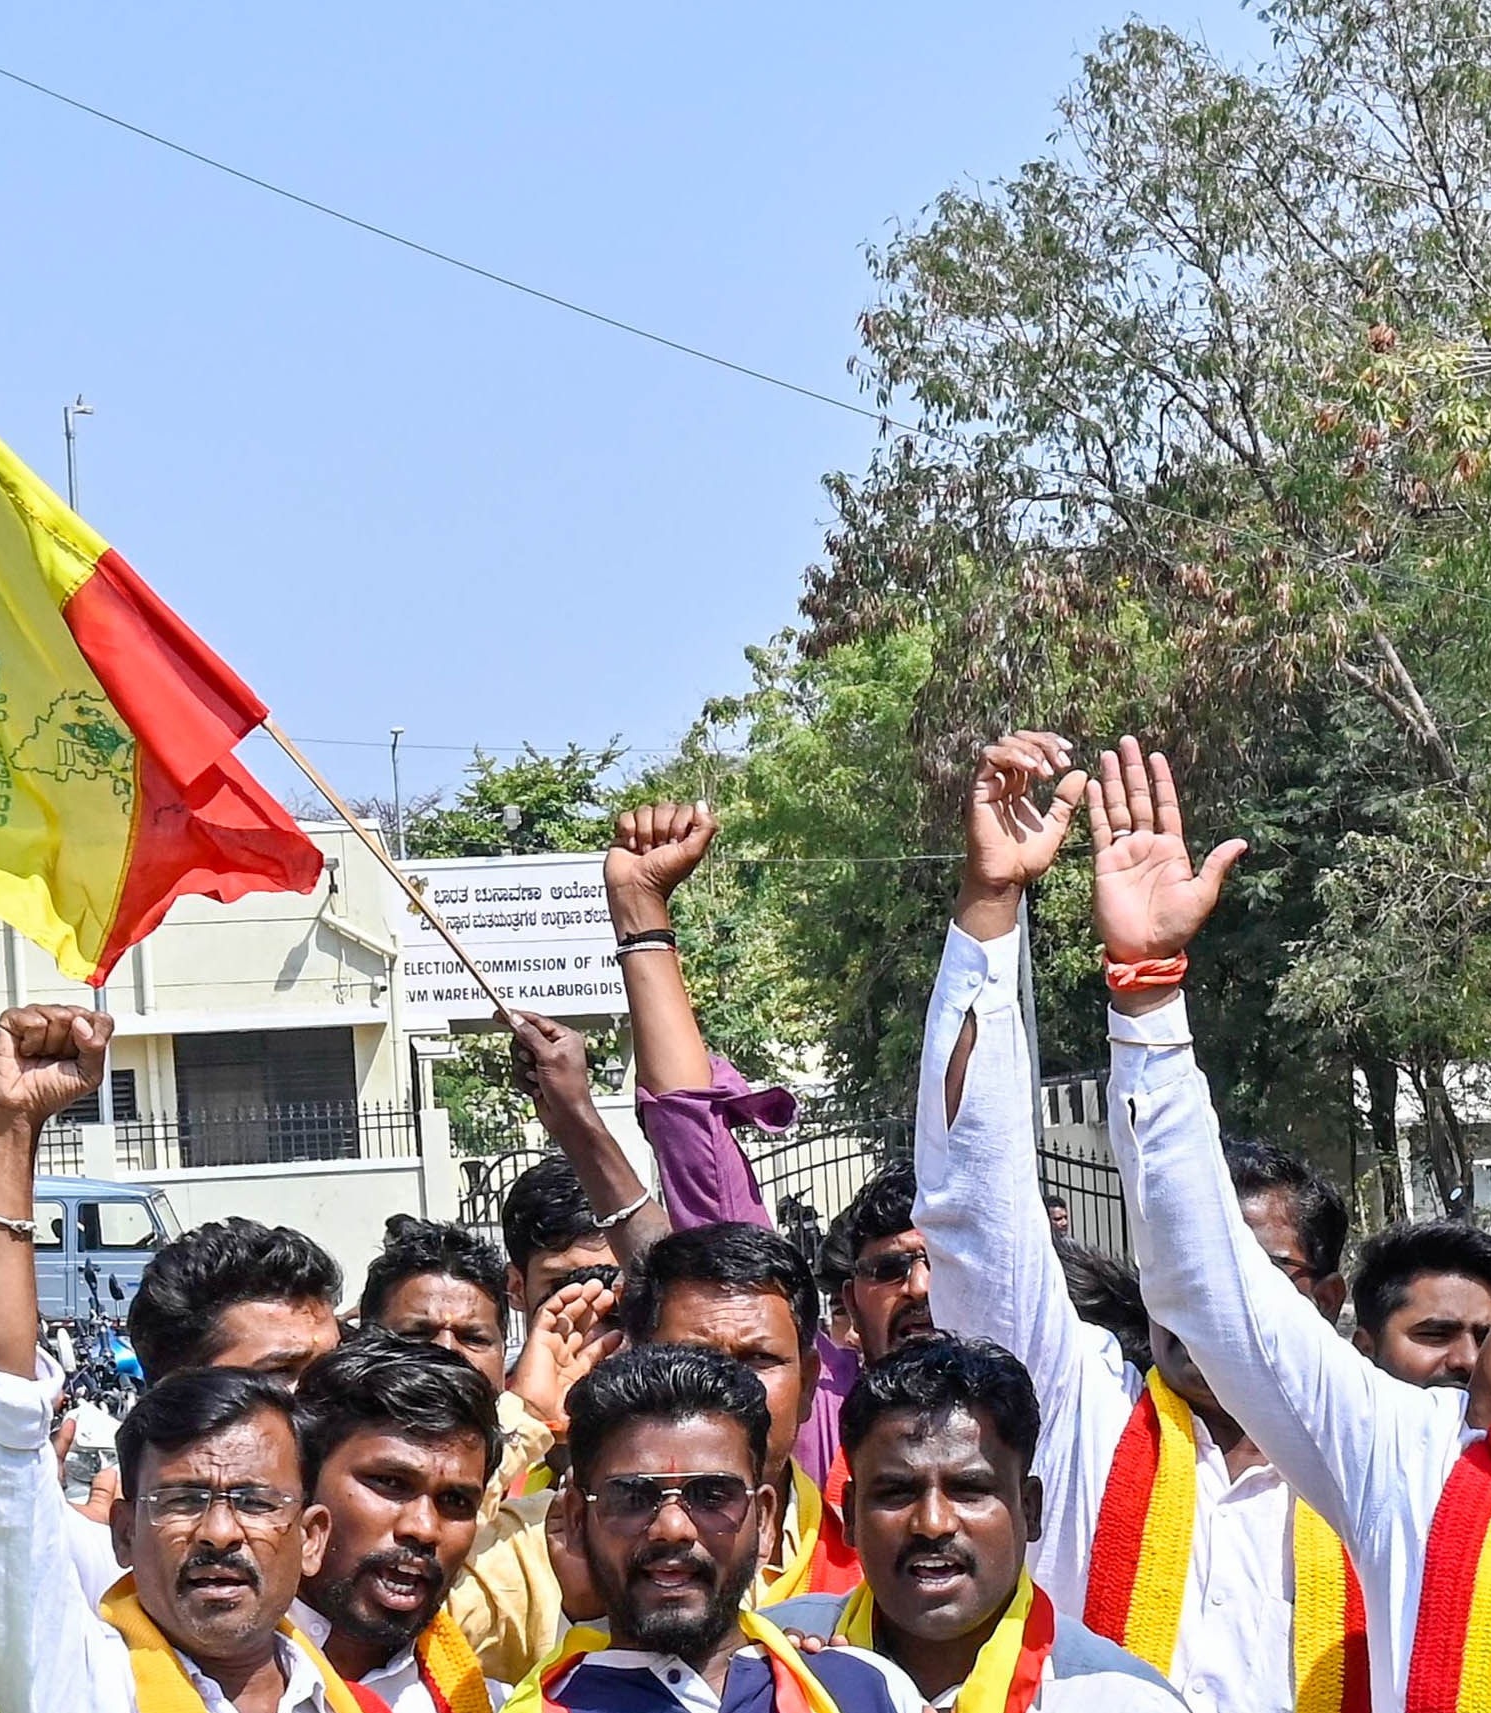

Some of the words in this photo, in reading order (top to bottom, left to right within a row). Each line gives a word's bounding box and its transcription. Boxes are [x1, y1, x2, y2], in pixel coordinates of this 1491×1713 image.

[434, 886, 468, 907] ಭಾರತ
[475, 883, 542, 902] ಚುನಾವಣಾ
[404, 961, 465, 976] ELECTION
[474, 957, 566, 973] COMMISSION
[574, 956, 592, 969] OF
[433, 986, 514, 1001] WAREHOSE
[519, 983, 598, 998] KALABURGI
